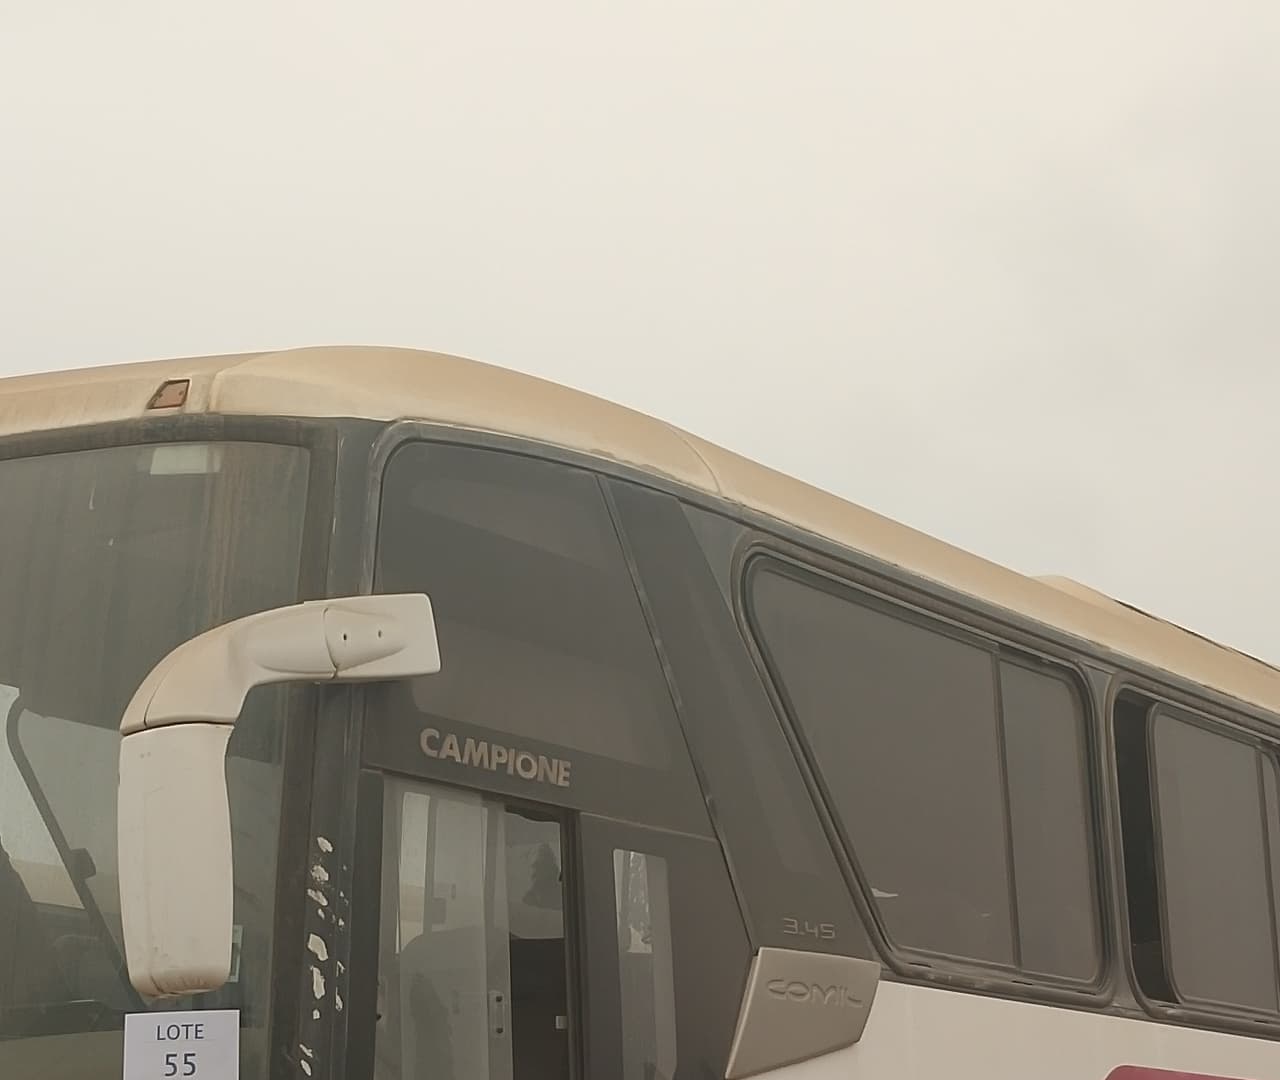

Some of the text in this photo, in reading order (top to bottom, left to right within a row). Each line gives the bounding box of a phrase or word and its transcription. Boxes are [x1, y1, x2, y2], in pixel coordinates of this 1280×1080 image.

[420, 727, 571, 787] CAMPIONE
[783, 917, 835, 939] 3.45
[767, 978, 863, 1008] COMIL
[156, 1023, 205, 1041] LOTE
[164, 1053, 197, 1077] 55
